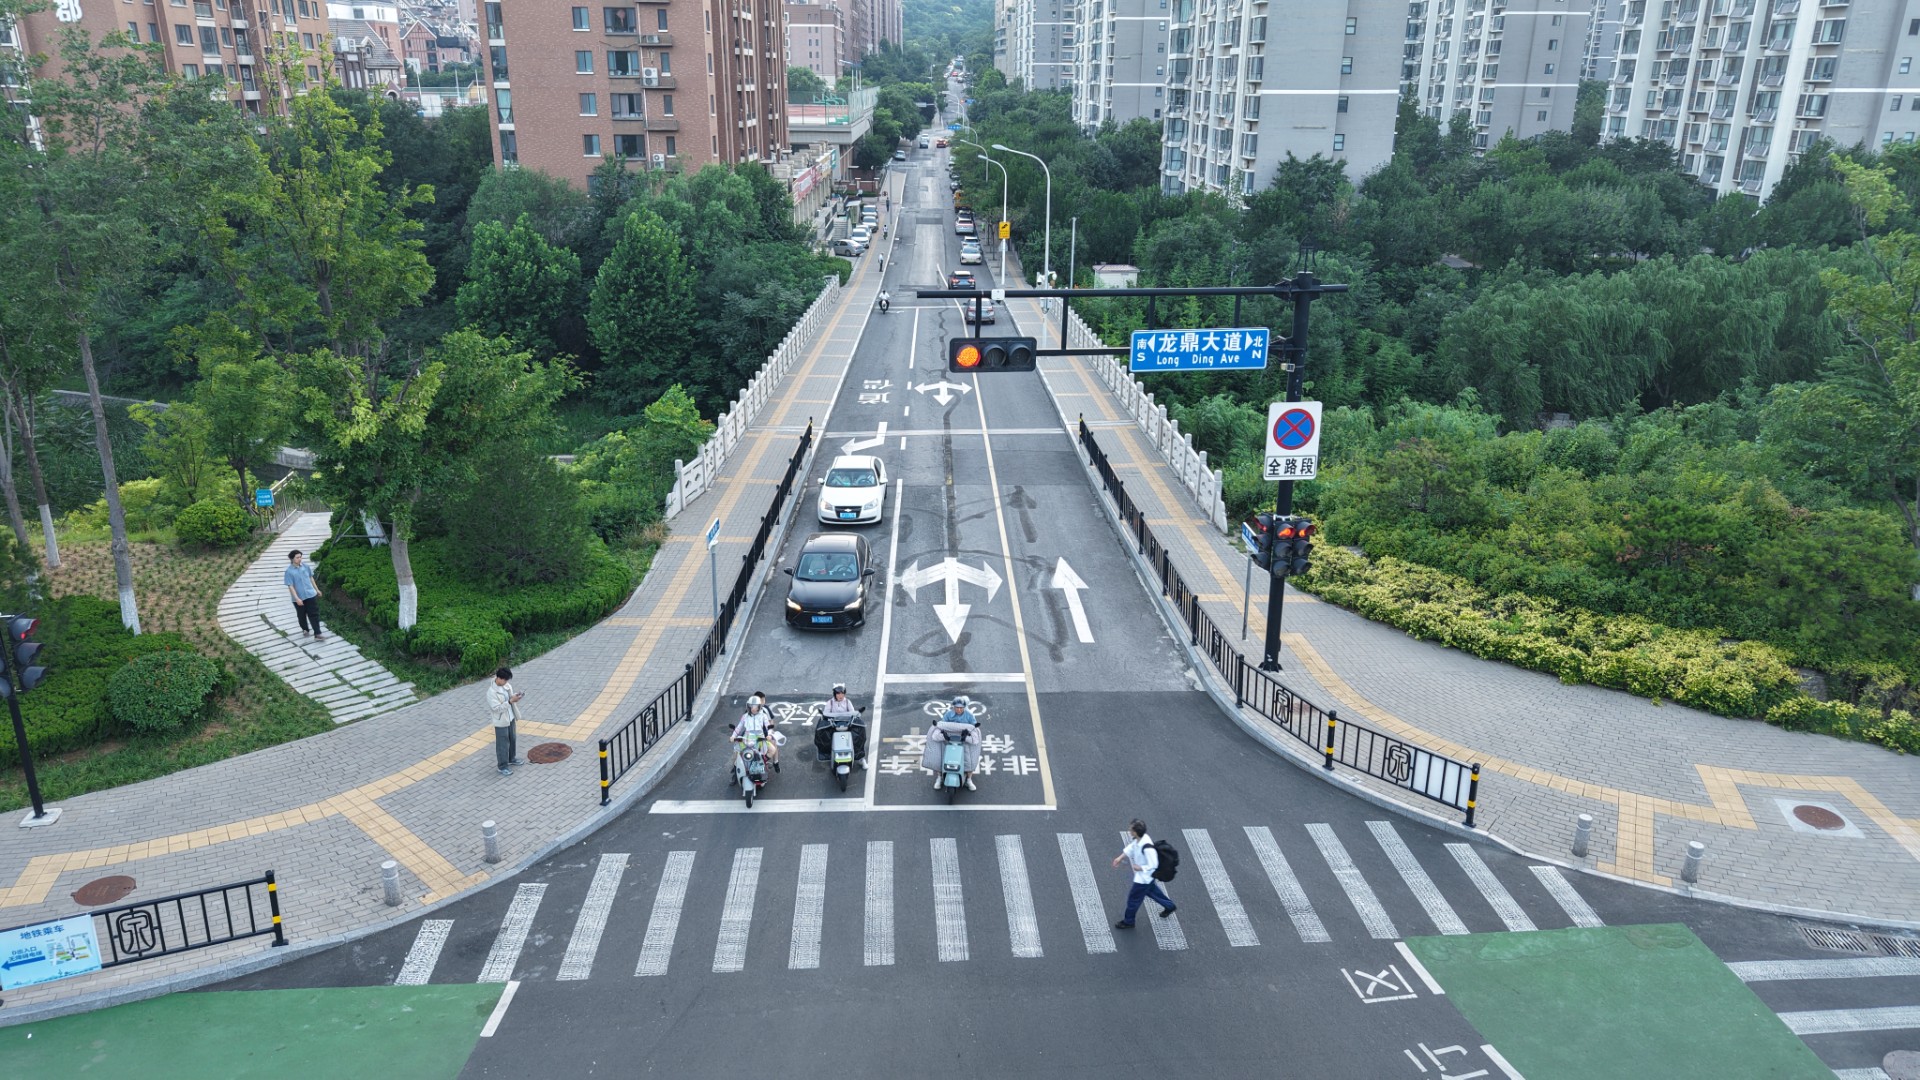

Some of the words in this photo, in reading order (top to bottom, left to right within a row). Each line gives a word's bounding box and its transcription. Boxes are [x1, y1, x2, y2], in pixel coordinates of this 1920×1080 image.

[1137, 338, 1147, 350] 南
[1158, 332, 1242, 353] 龙鼎大道
[1252, 335, 1263, 348] 北
[1137, 352, 1146, 362] S
[1157, 355, 1180, 367] Long
[1192, 354, 1214, 366] Ding
[1220, 353, 1240, 364] Ave
[1252, 350, 1262, 359] N
[1267, 457, 1314, 476] 全路段
[20, 924, 65, 940] 地铁乘车
